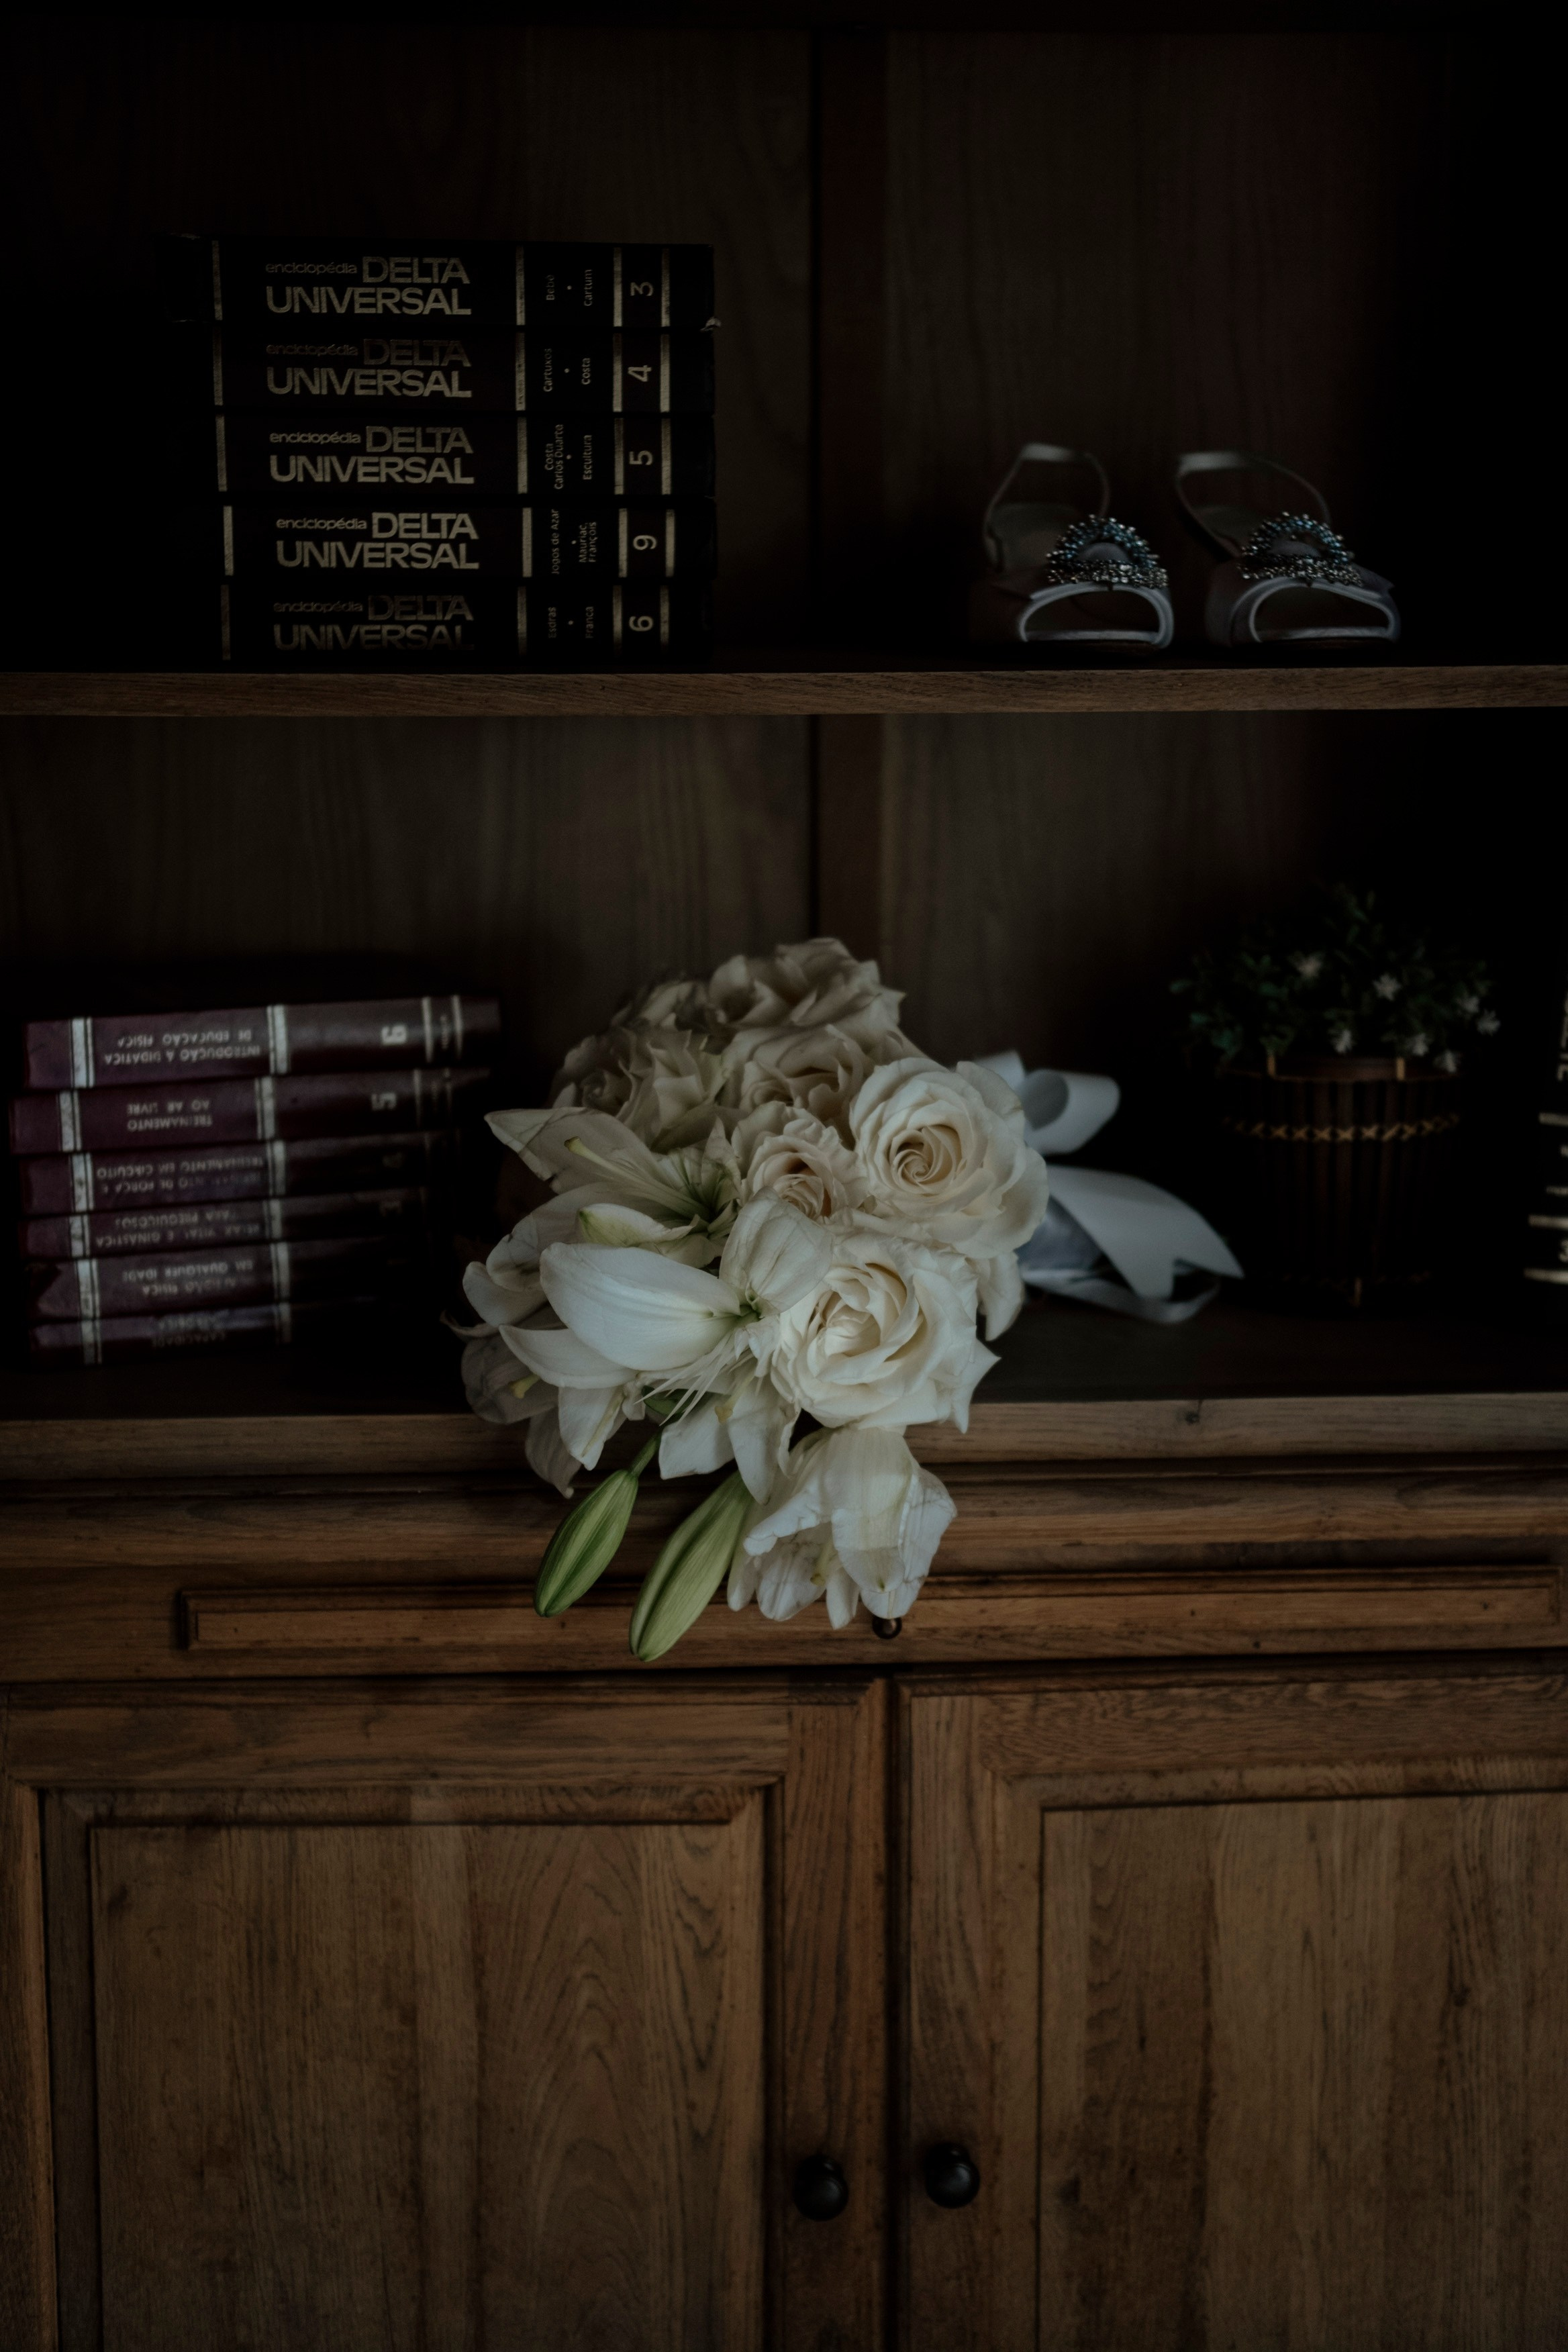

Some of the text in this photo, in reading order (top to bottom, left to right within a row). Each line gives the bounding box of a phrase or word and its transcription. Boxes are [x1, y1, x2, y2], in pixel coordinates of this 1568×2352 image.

[266, 256, 471, 285] enciclopédia DELTA
[266, 287, 473, 316] UNIVERSAL
[583, 268, 593, 307] Cartum
[630, 281, 655, 297] 3
[266, 339, 473, 367] enciclopédia DELTA
[268, 368, 473, 399] UNIVERSAL
[543, 348, 554, 393] Cartuxos
[581, 356, 592, 386] Costa
[627, 364, 653, 383] 4
[270, 426, 475, 454] enciclopédia DELTA
[271, 455, 476, 485] UNIVERSAL
[544, 443, 554, 471] Costa
[554, 424, 564, 490] Carlos Duarte
[583, 435, 593, 481] Escultura
[628, 450, 654, 467] 5
[277, 512, 480, 540] enciclopédia DELTA
[277, 541, 481, 571] UNIVERSAL
[550, 509, 561, 575] Jogos de Azar
[587, 522, 598, 563] François
[632, 534, 658, 551] 9
[368, 595, 475, 622] DELTA
[585, 606, 595, 639] Franca
[548, 607, 558, 639] Esdras
[628, 616, 654, 632] 6
[274, 624, 476, 651] UNIVERSAL
[239, 1030, 252, 1041] DE
[128, 1100, 210, 1116] AO AR LIVRE
[128, 1116, 213, 1132] TREINAMENTO
